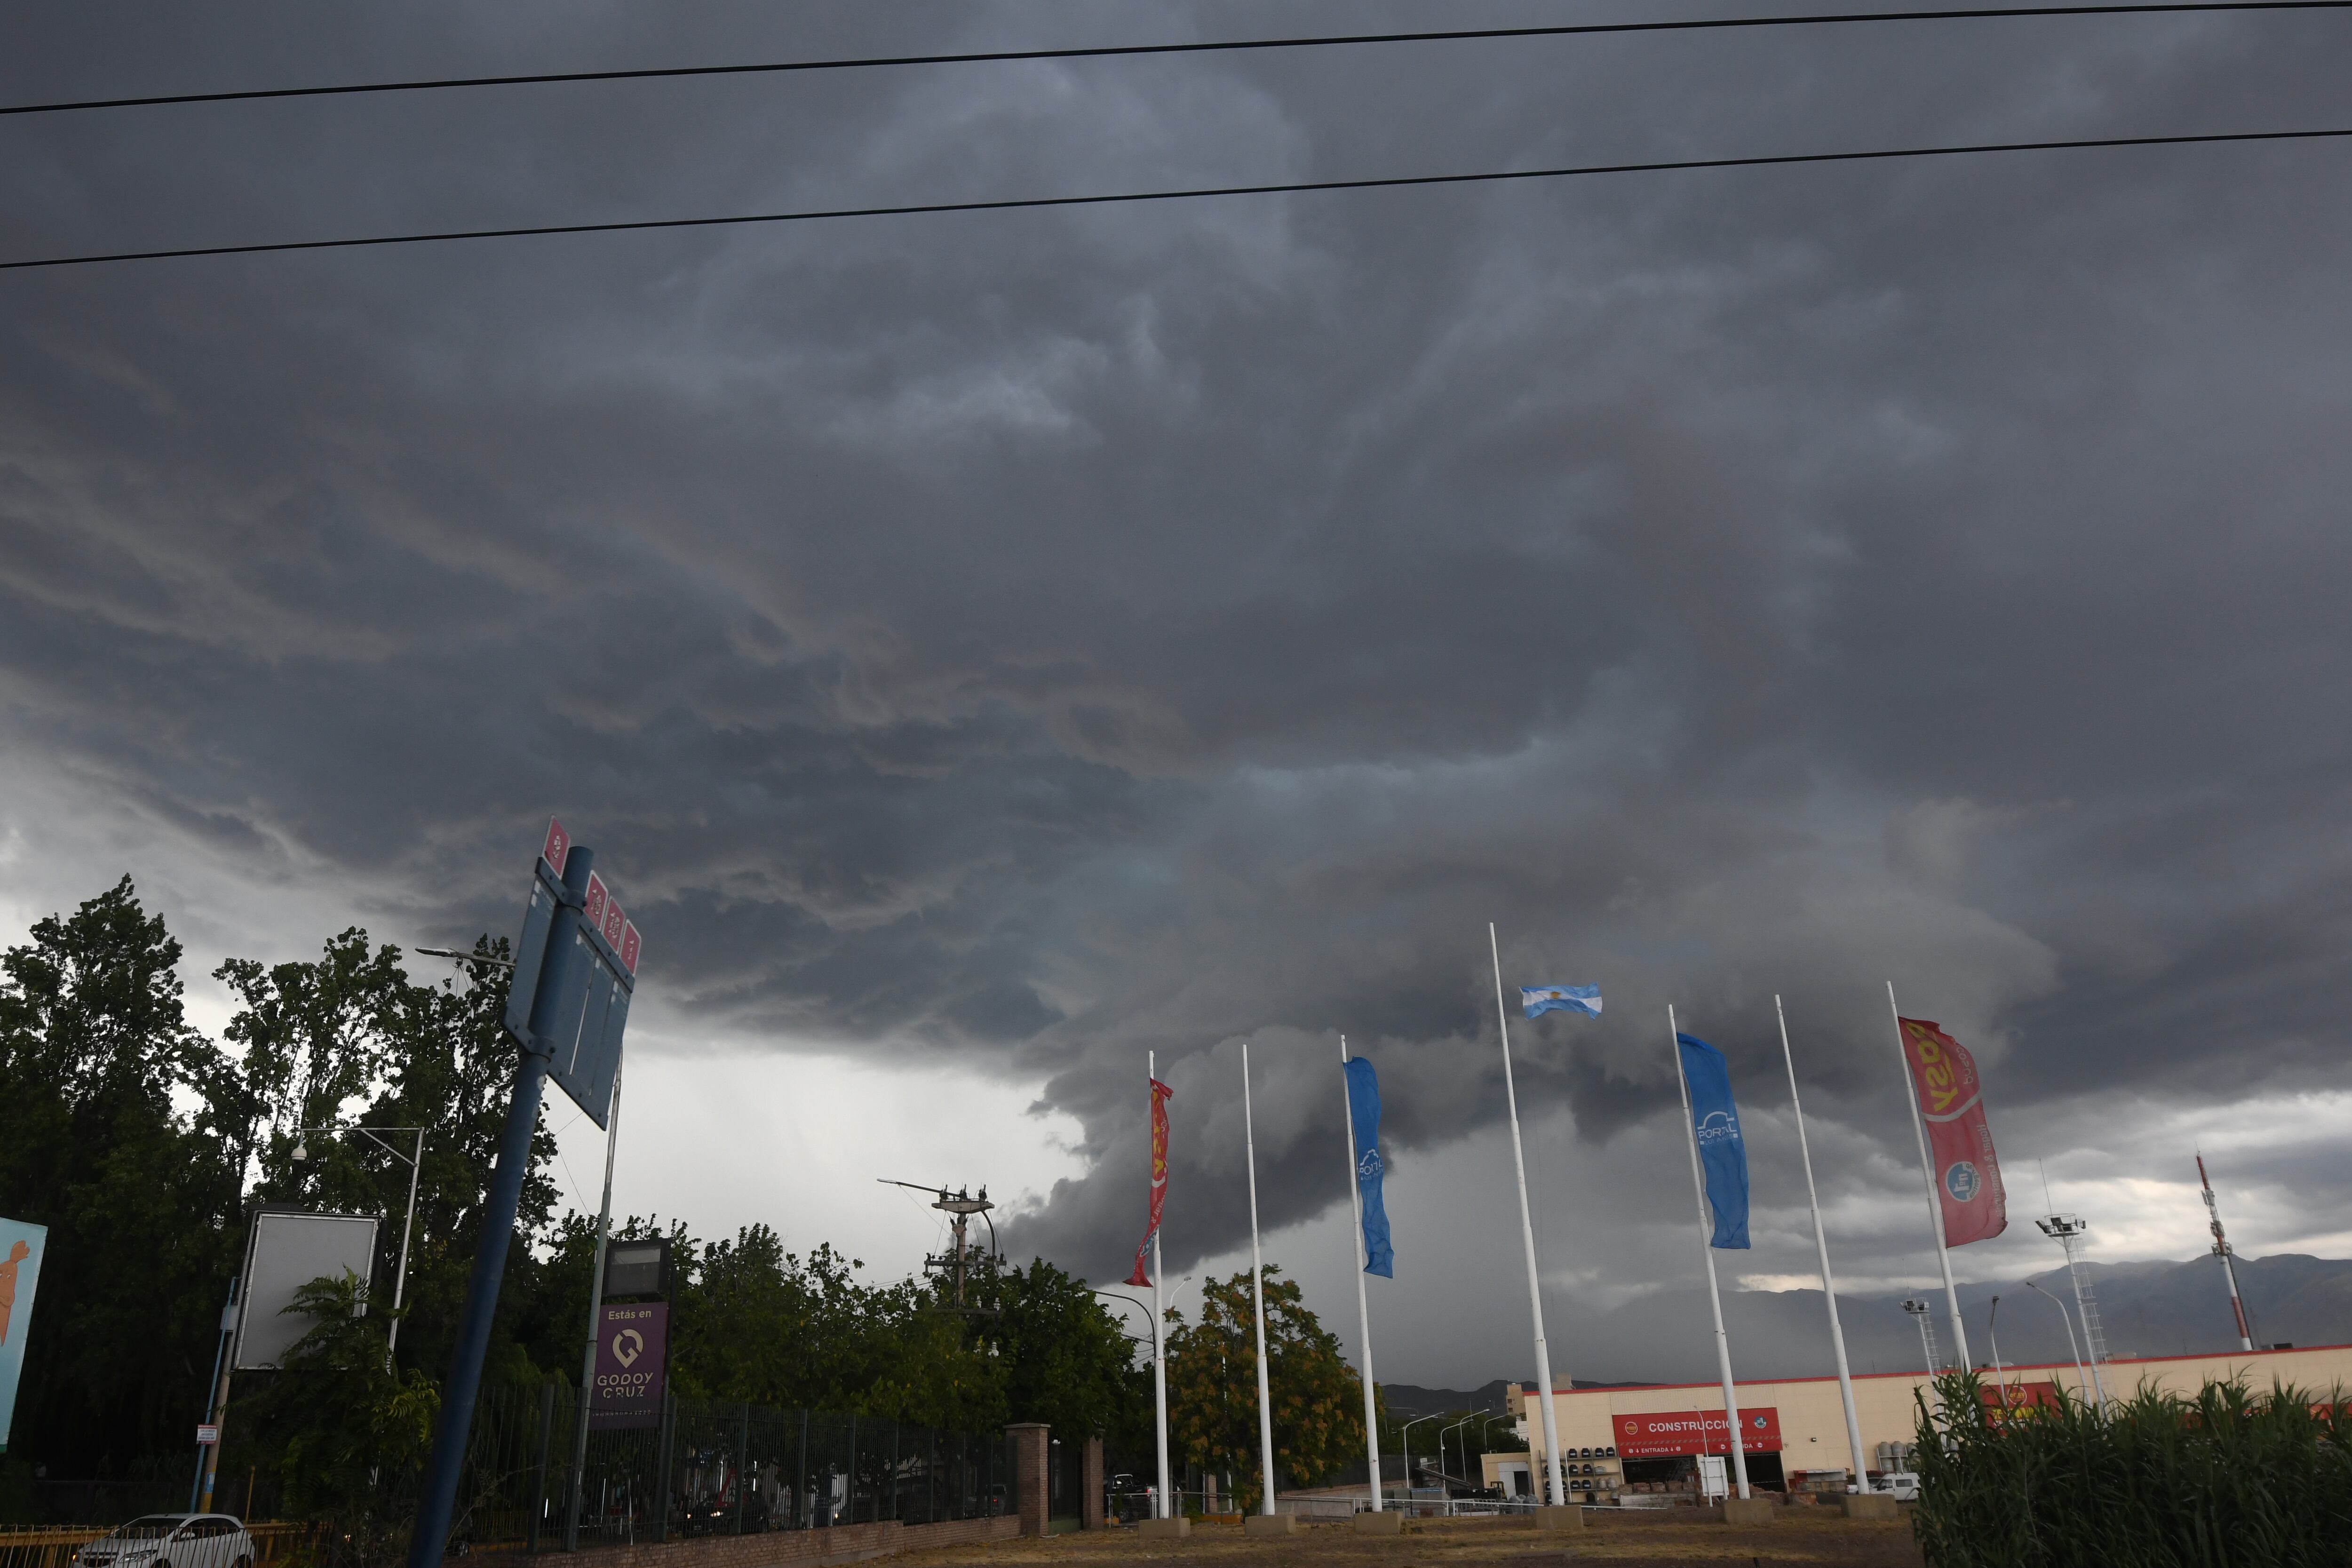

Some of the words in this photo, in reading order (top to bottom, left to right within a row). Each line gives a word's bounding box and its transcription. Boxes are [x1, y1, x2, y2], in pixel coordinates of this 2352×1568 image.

[608, 1310, 636, 1320] Estás
[597, 1372, 654, 1386] GODOY
[603, 1385, 645, 1399] CRUZ
